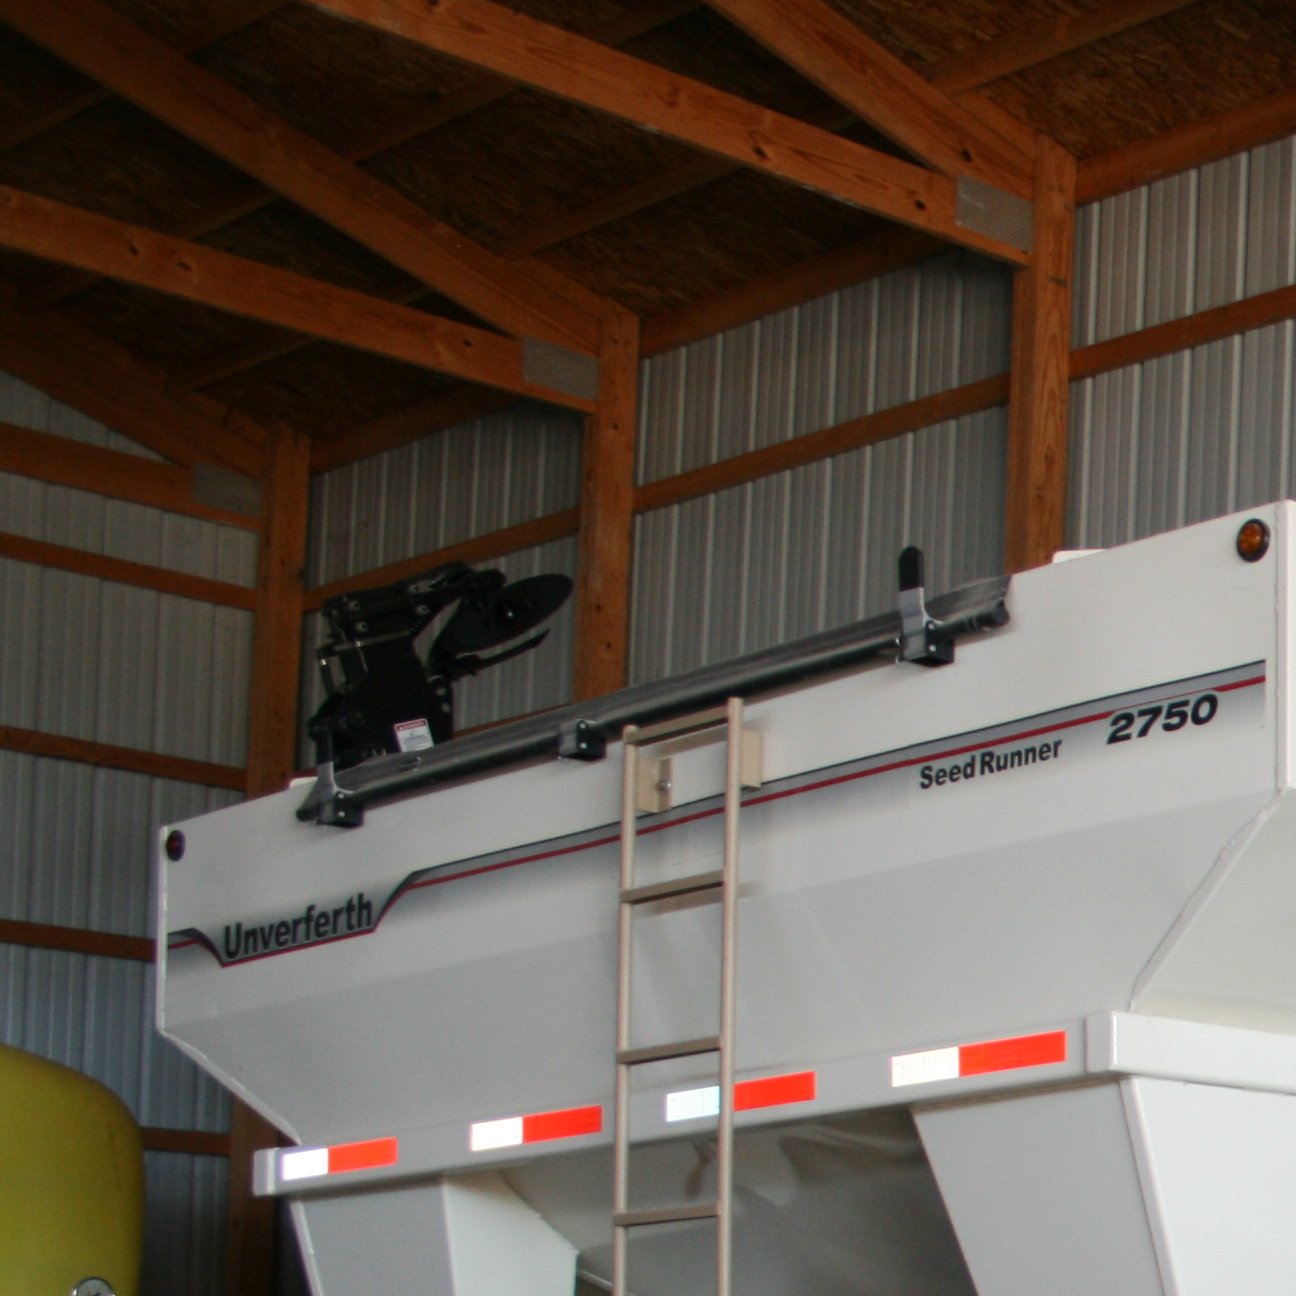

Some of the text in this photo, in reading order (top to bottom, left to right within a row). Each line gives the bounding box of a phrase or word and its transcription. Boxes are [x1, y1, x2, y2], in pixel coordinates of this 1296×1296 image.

[919, 693, 1218, 790] Seed Runner 2750
[223, 893, 373, 959] Unverferth
